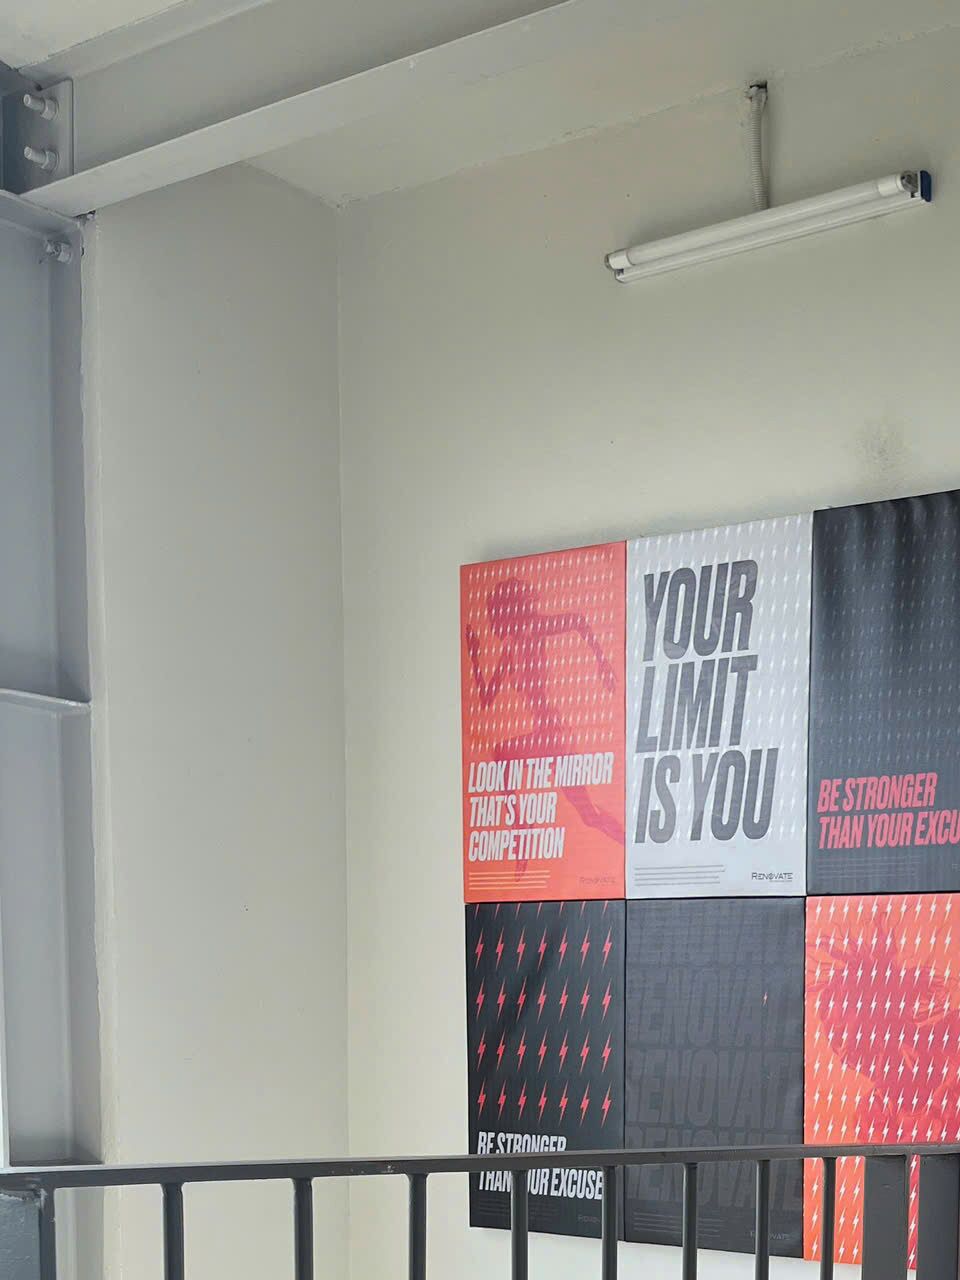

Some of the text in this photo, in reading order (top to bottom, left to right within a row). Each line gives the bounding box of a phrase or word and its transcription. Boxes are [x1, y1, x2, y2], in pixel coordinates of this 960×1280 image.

[643, 560, 758, 661] YOUR
[635, 655, 758, 753] LIMIT
[468, 752, 614, 793] LOOK IN THE MIRROR
[817, 772, 938, 813] BE STRONGER
[470, 792, 557, 827] THAT'S YOUR
[634, 748, 778, 843] IS YOU
[468, 827, 565, 861] COMPETITION
[818, 815, 864, 849] THAN
[867, 812, 914, 847] YOUR
[550, 1167, 604, 1200] EXCUSE
